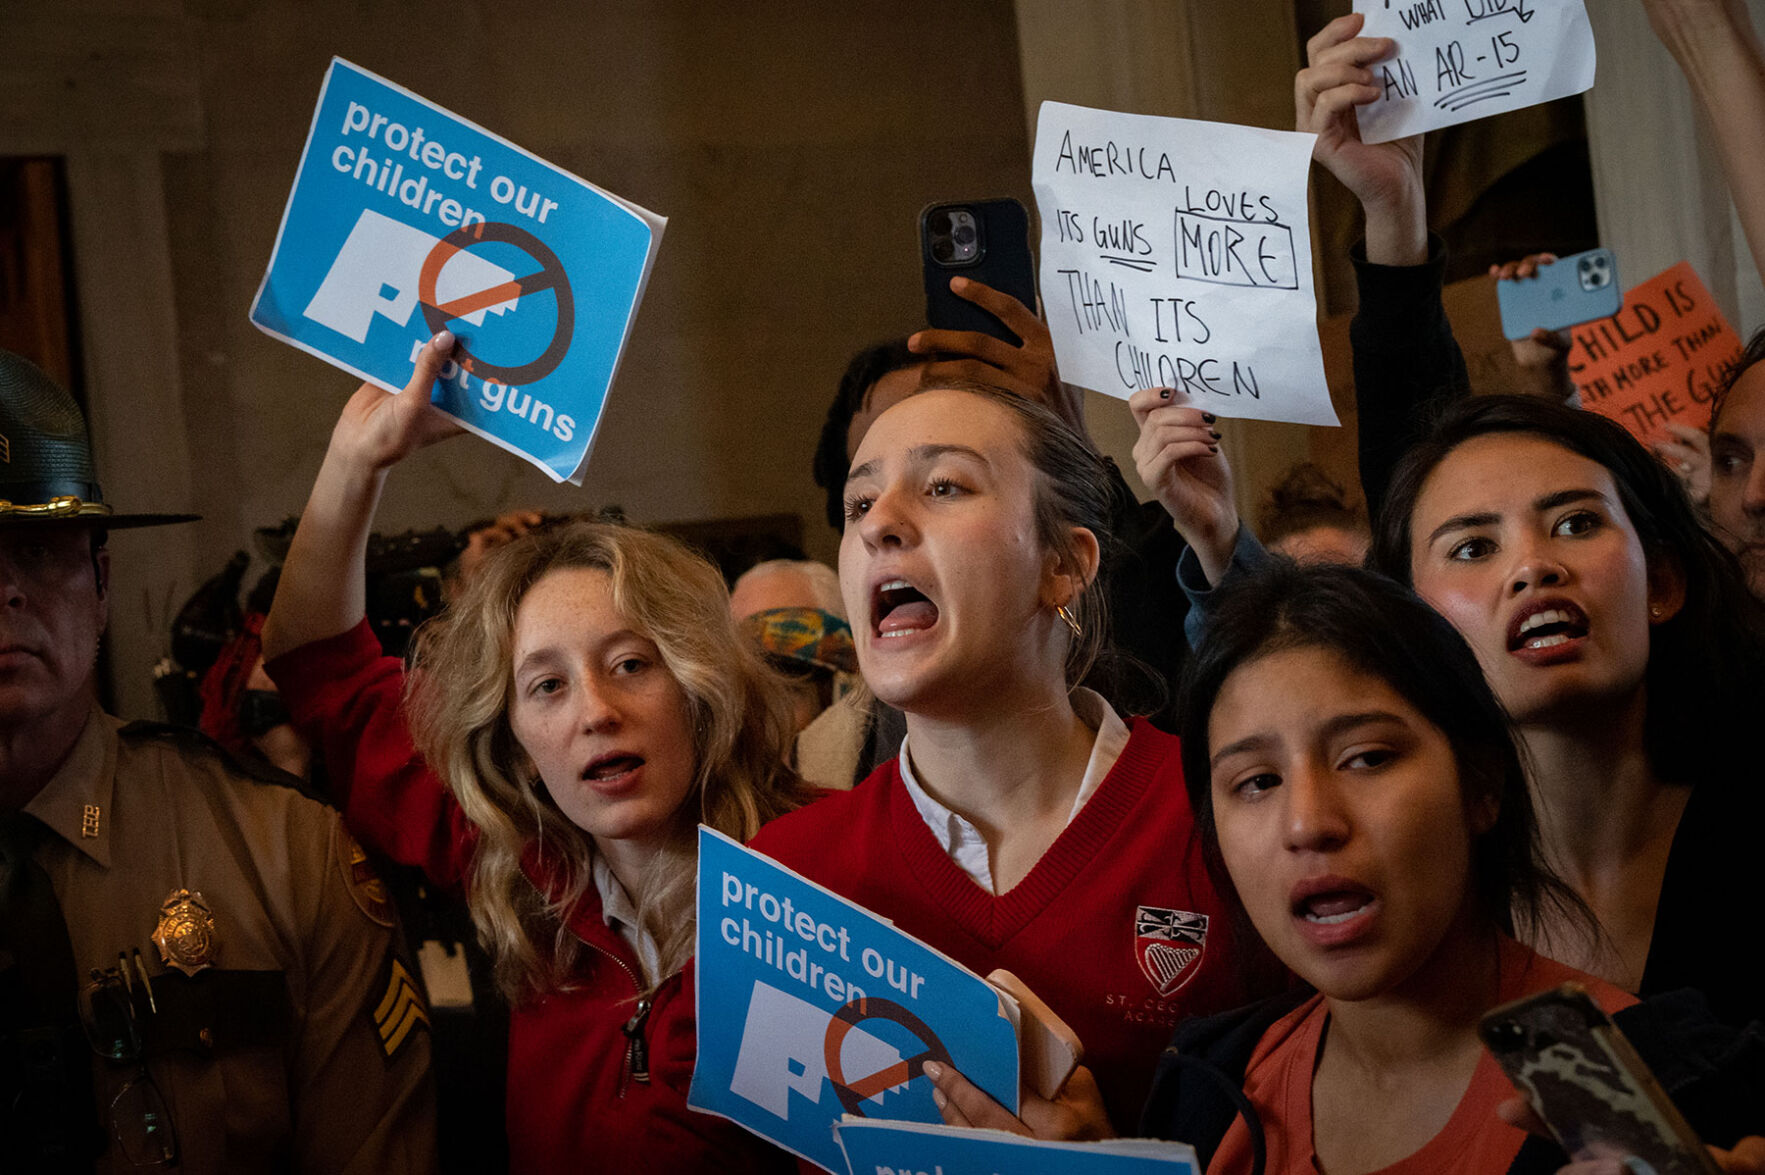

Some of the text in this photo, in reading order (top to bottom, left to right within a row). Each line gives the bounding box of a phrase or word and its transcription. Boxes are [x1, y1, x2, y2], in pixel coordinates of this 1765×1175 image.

[1399, 0, 1446, 31] WHAT
[1382, 30, 1520, 101] AN AR-15
[341, 101, 559, 225] protect our
[1056, 130, 1177, 184] AMERICA
[331, 145, 487, 241] children
[1186, 186, 1278, 223] LOVES
[1057, 209, 1153, 256] ITS GUNS
[1181, 217, 1278, 285] MORE
[1057, 269, 1211, 344] THAN ITS
[1663, 281, 1696, 318] IS
[1612, 353, 1669, 392] MORE
[1671, 314, 1723, 362] THAN
[480, 377, 577, 442] guns
[1622, 390, 1685, 434] THE
[720, 916, 868, 1017] children
[721, 871, 926, 1000] protect our
